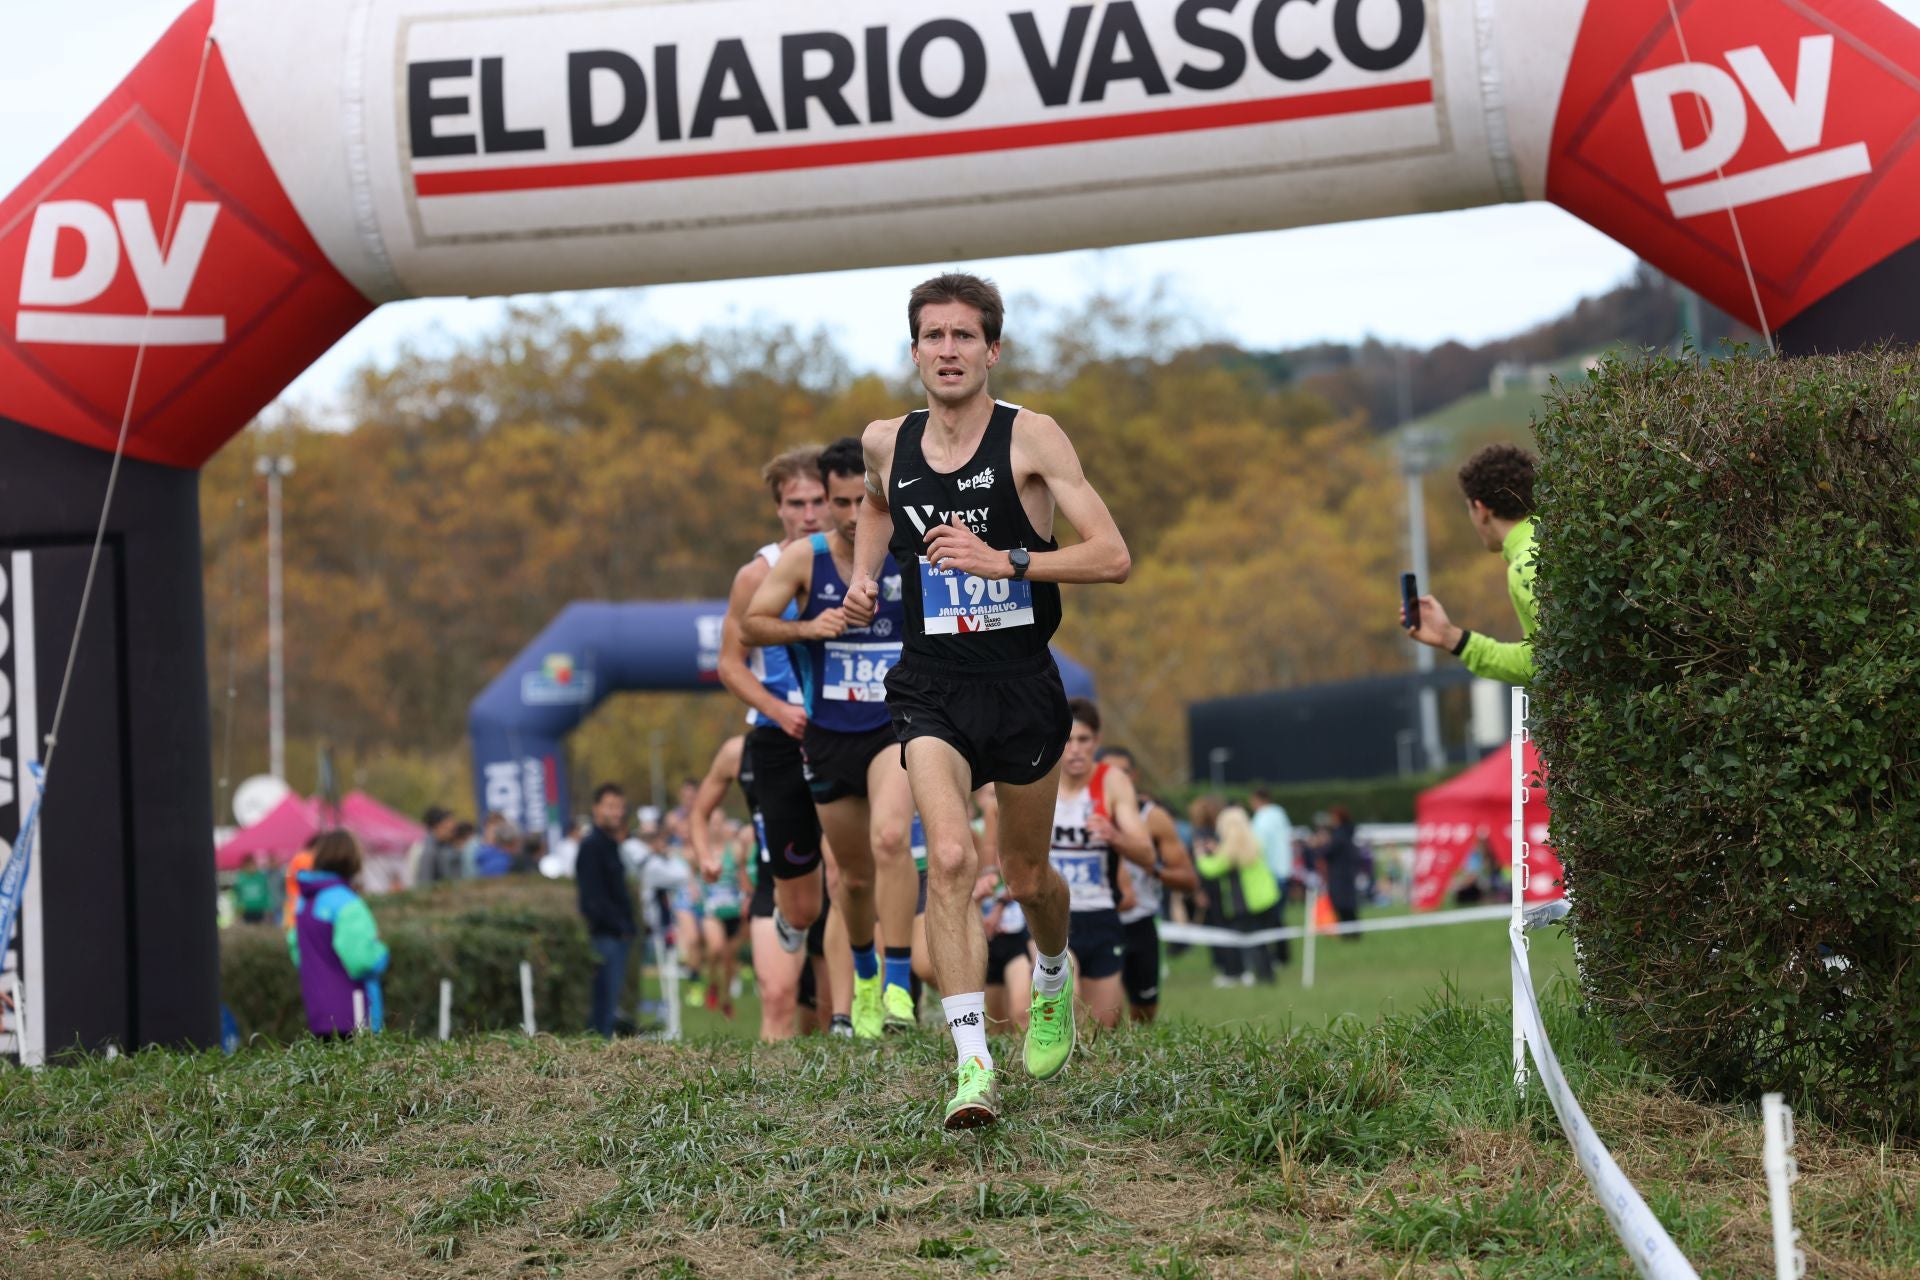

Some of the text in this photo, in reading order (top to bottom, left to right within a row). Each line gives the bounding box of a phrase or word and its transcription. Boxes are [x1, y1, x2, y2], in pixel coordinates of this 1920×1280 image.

[409, 0, 1426, 158] EL DIARIO VASCO
[1631, 34, 1834, 185] DV
[18, 198, 222, 311] DV
[938, 607, 967, 617] JAIRO
[969, 602, 1018, 615] GRIJALVO
[944, 575, 1010, 606] 190
[842, 658, 889, 682] 186
